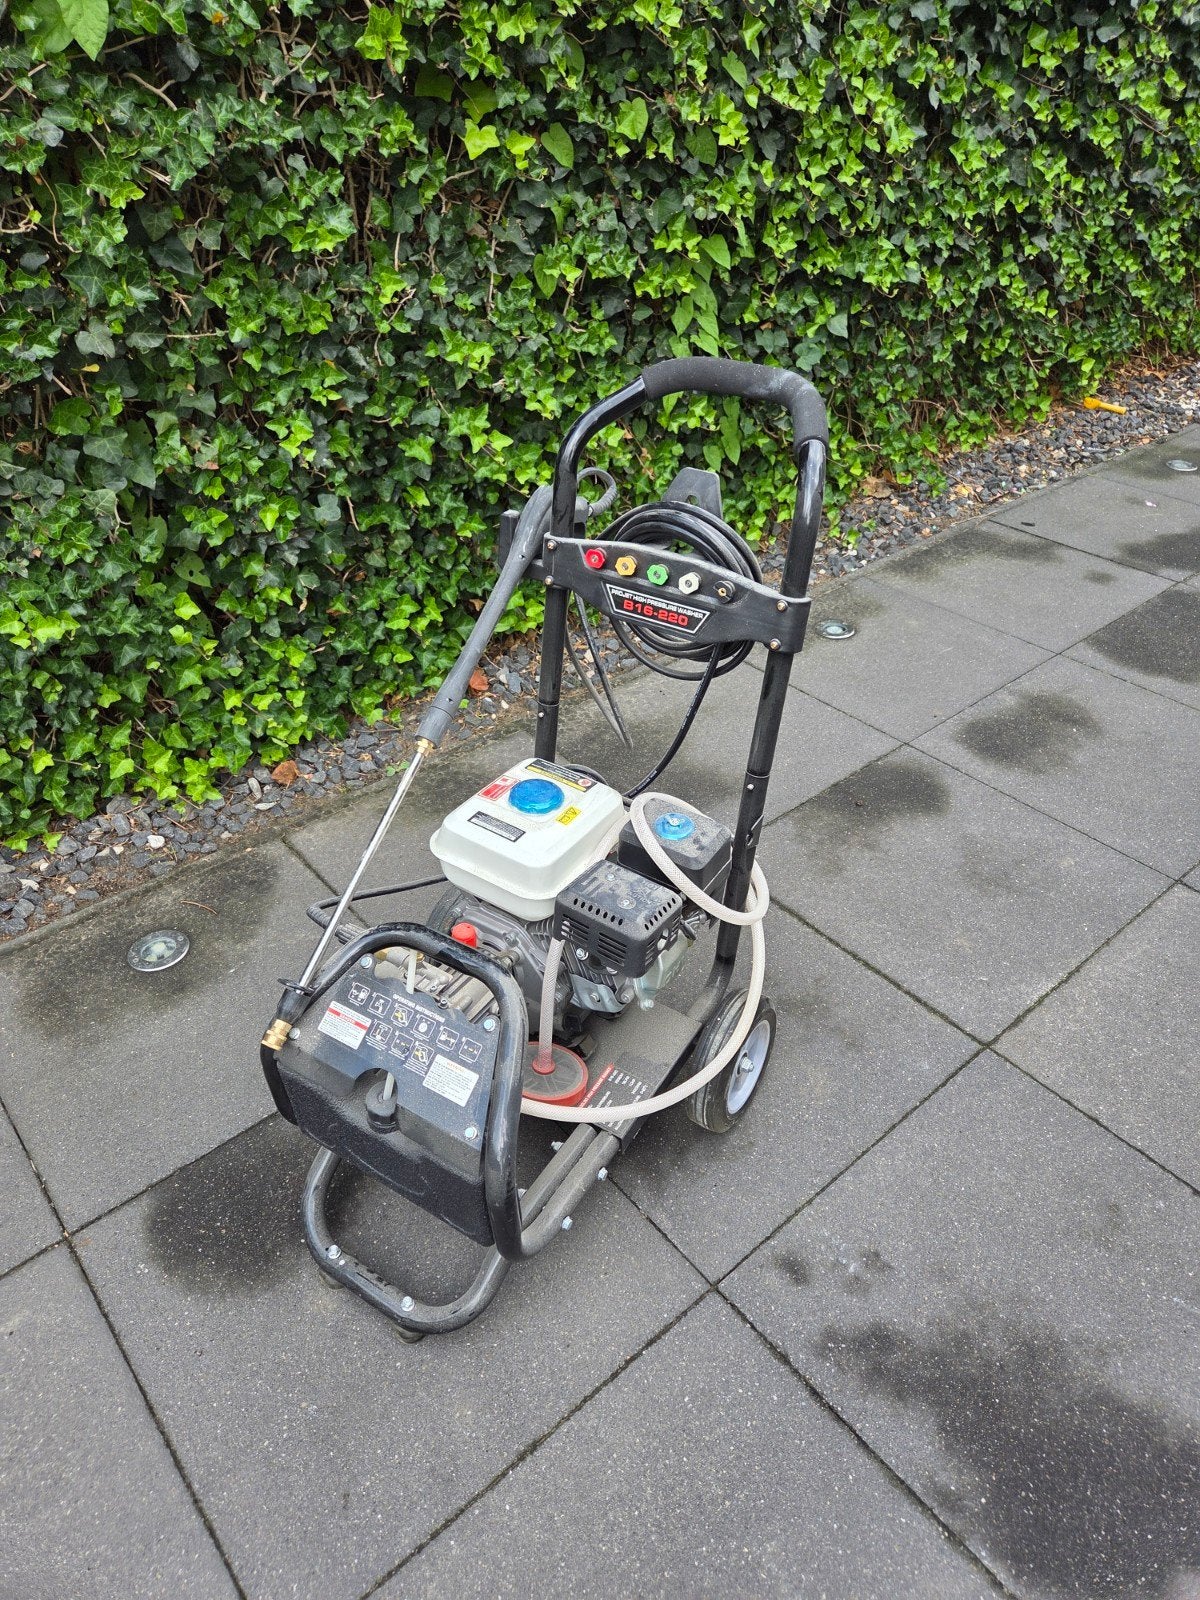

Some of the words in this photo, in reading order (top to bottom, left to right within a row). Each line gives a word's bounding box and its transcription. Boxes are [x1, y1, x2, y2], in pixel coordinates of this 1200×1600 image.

[611, 589, 634, 600] PROJET
[633, 594, 647, 604] HIGH
[646, 598, 678, 612] PRESSURE
[677, 607, 704, 619] WASHER
[623, 599, 689, 626] B16-220
